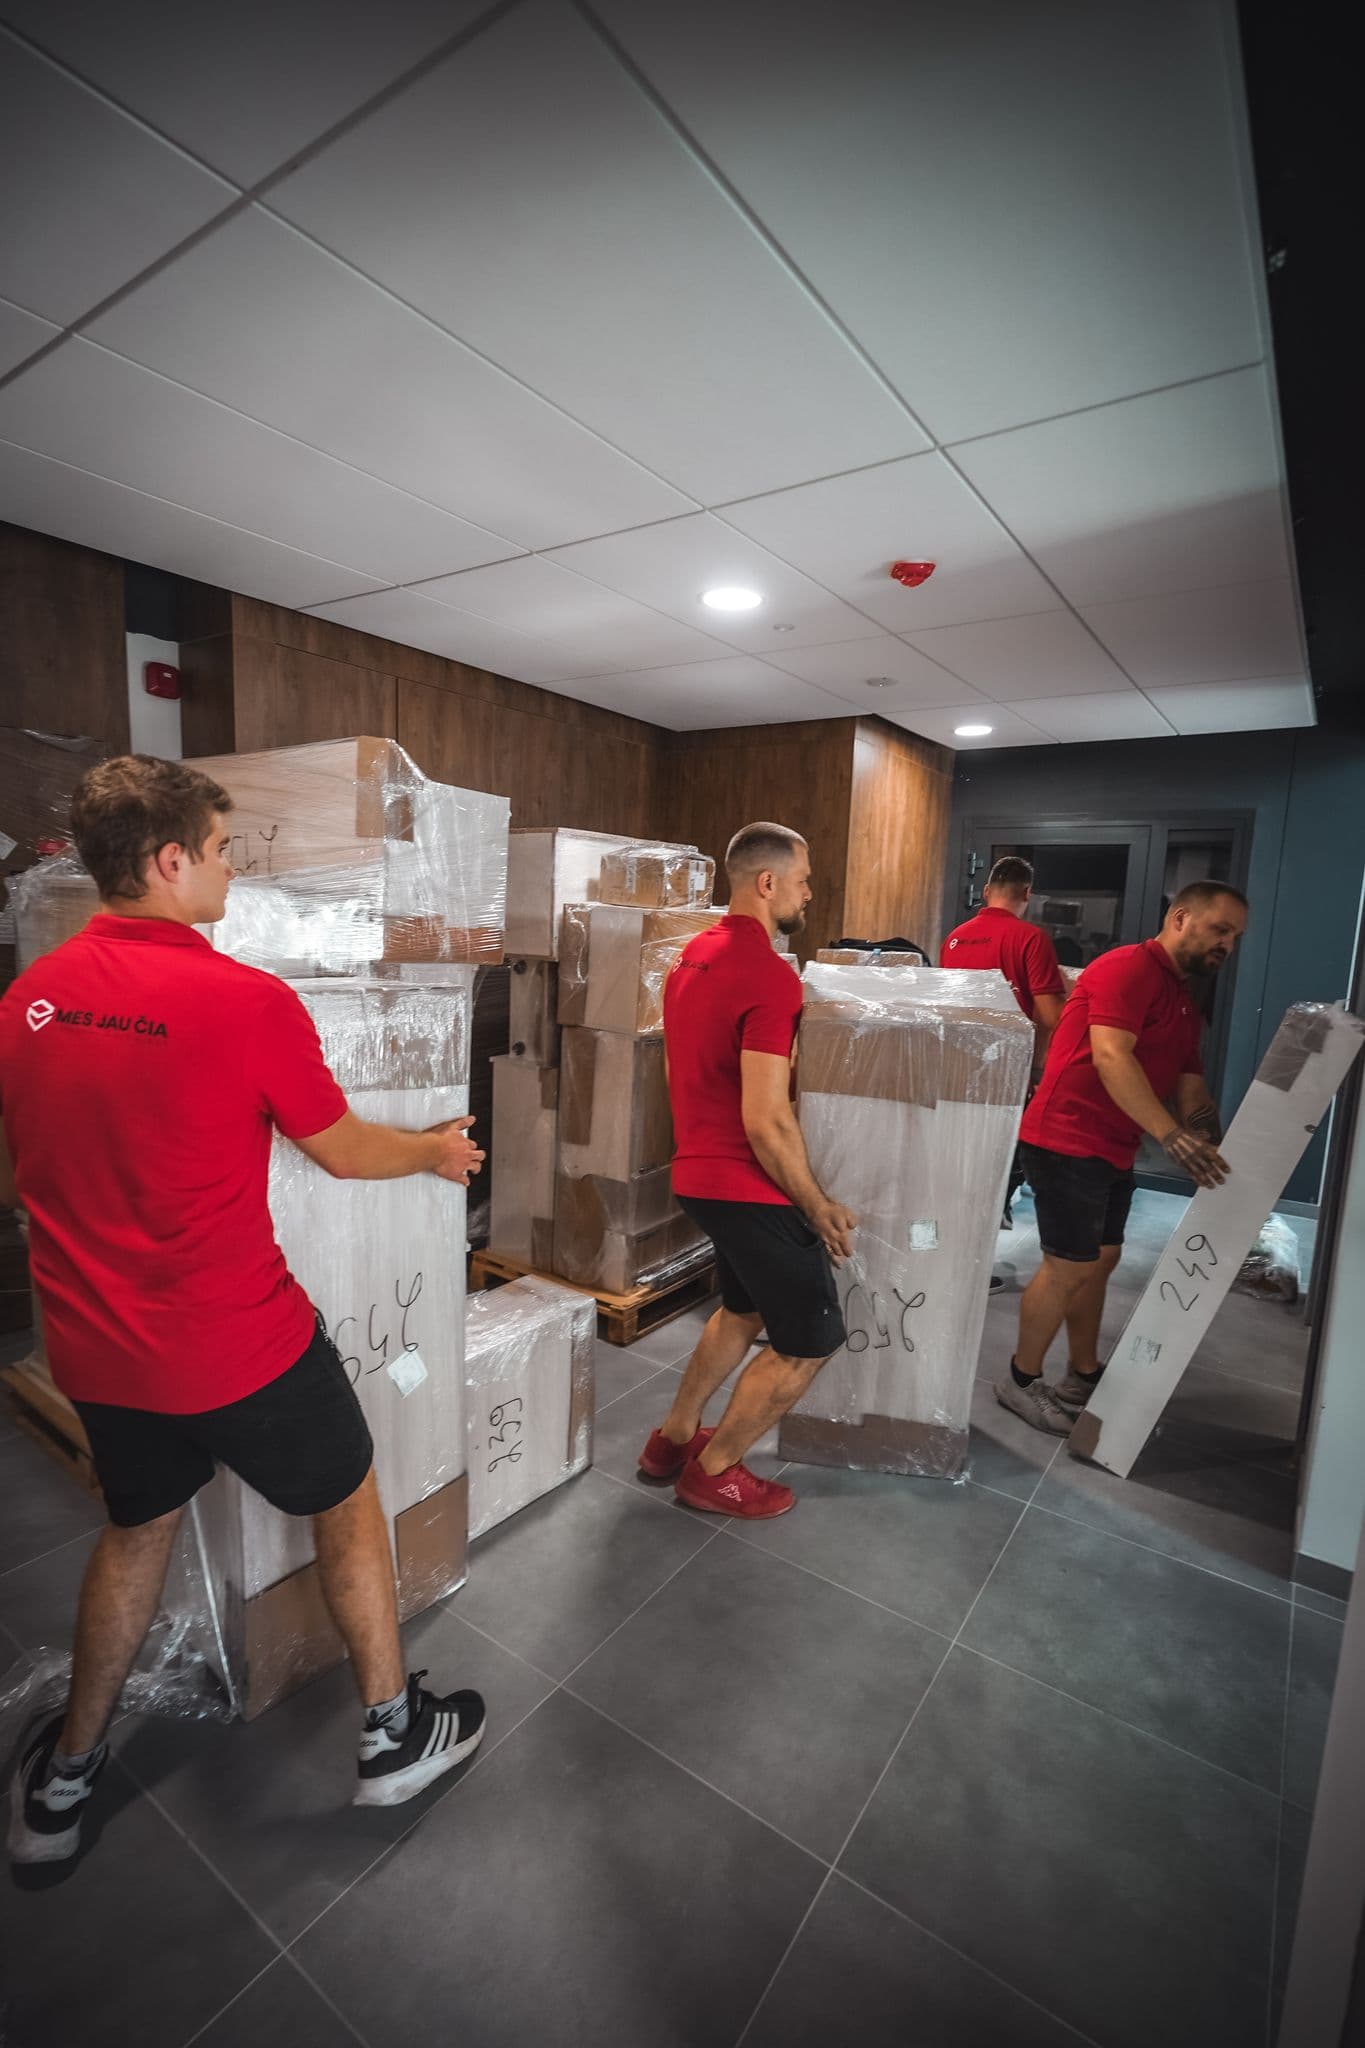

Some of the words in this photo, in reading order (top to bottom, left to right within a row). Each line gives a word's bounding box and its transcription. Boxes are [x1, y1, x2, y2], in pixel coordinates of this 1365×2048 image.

[55, 1008, 93, 1027] MES
[96, 1015, 131, 1032] JAU
[134, 1015, 168, 1039] ČIA
[1160, 1233, 1218, 1312] 249
[487, 1397, 524, 1473] 239
